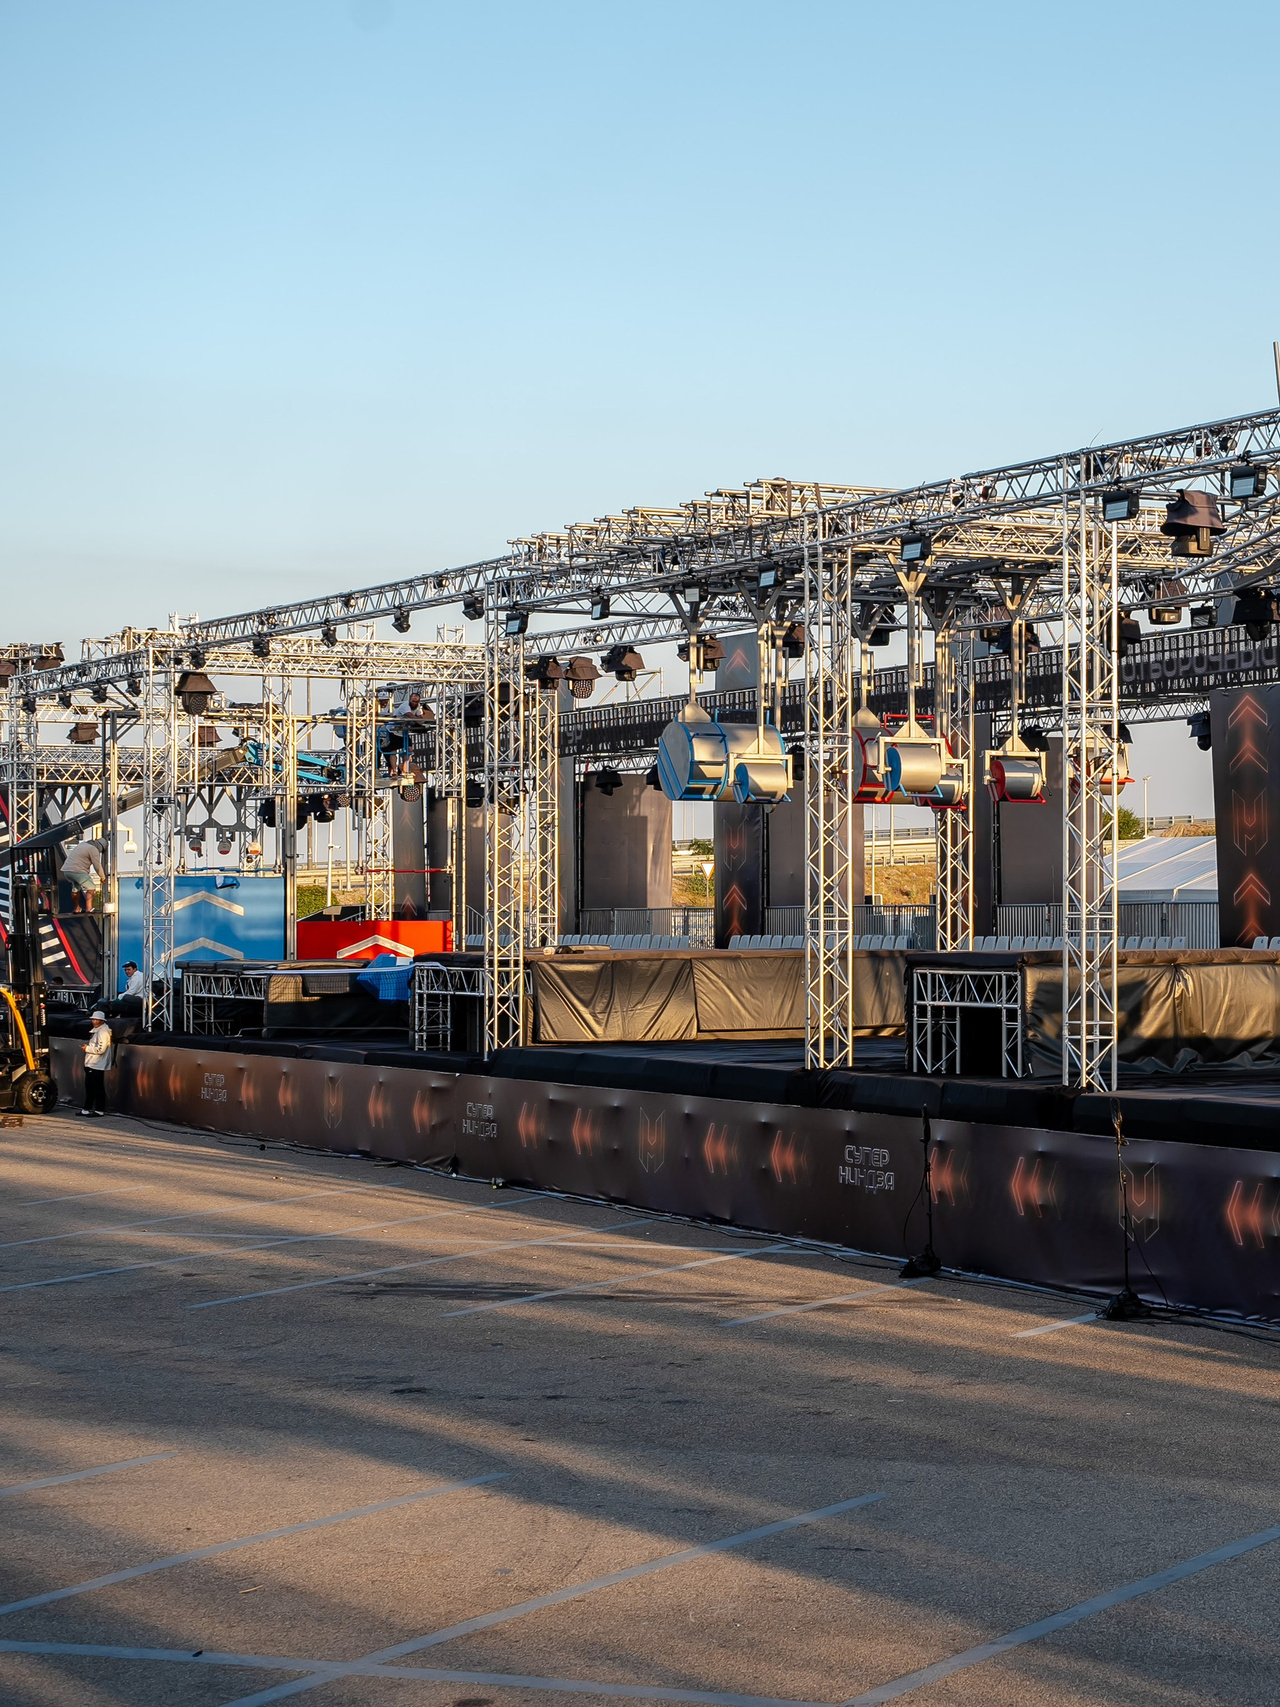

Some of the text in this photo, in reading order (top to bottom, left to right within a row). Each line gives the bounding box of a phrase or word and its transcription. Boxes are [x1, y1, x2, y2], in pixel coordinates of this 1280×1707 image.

[466, 1102, 494, 1120] СУПЕР
[844, 1145, 890, 1167] СУПЕР
[838, 1166, 895, 1194] НИНДЗЯ
